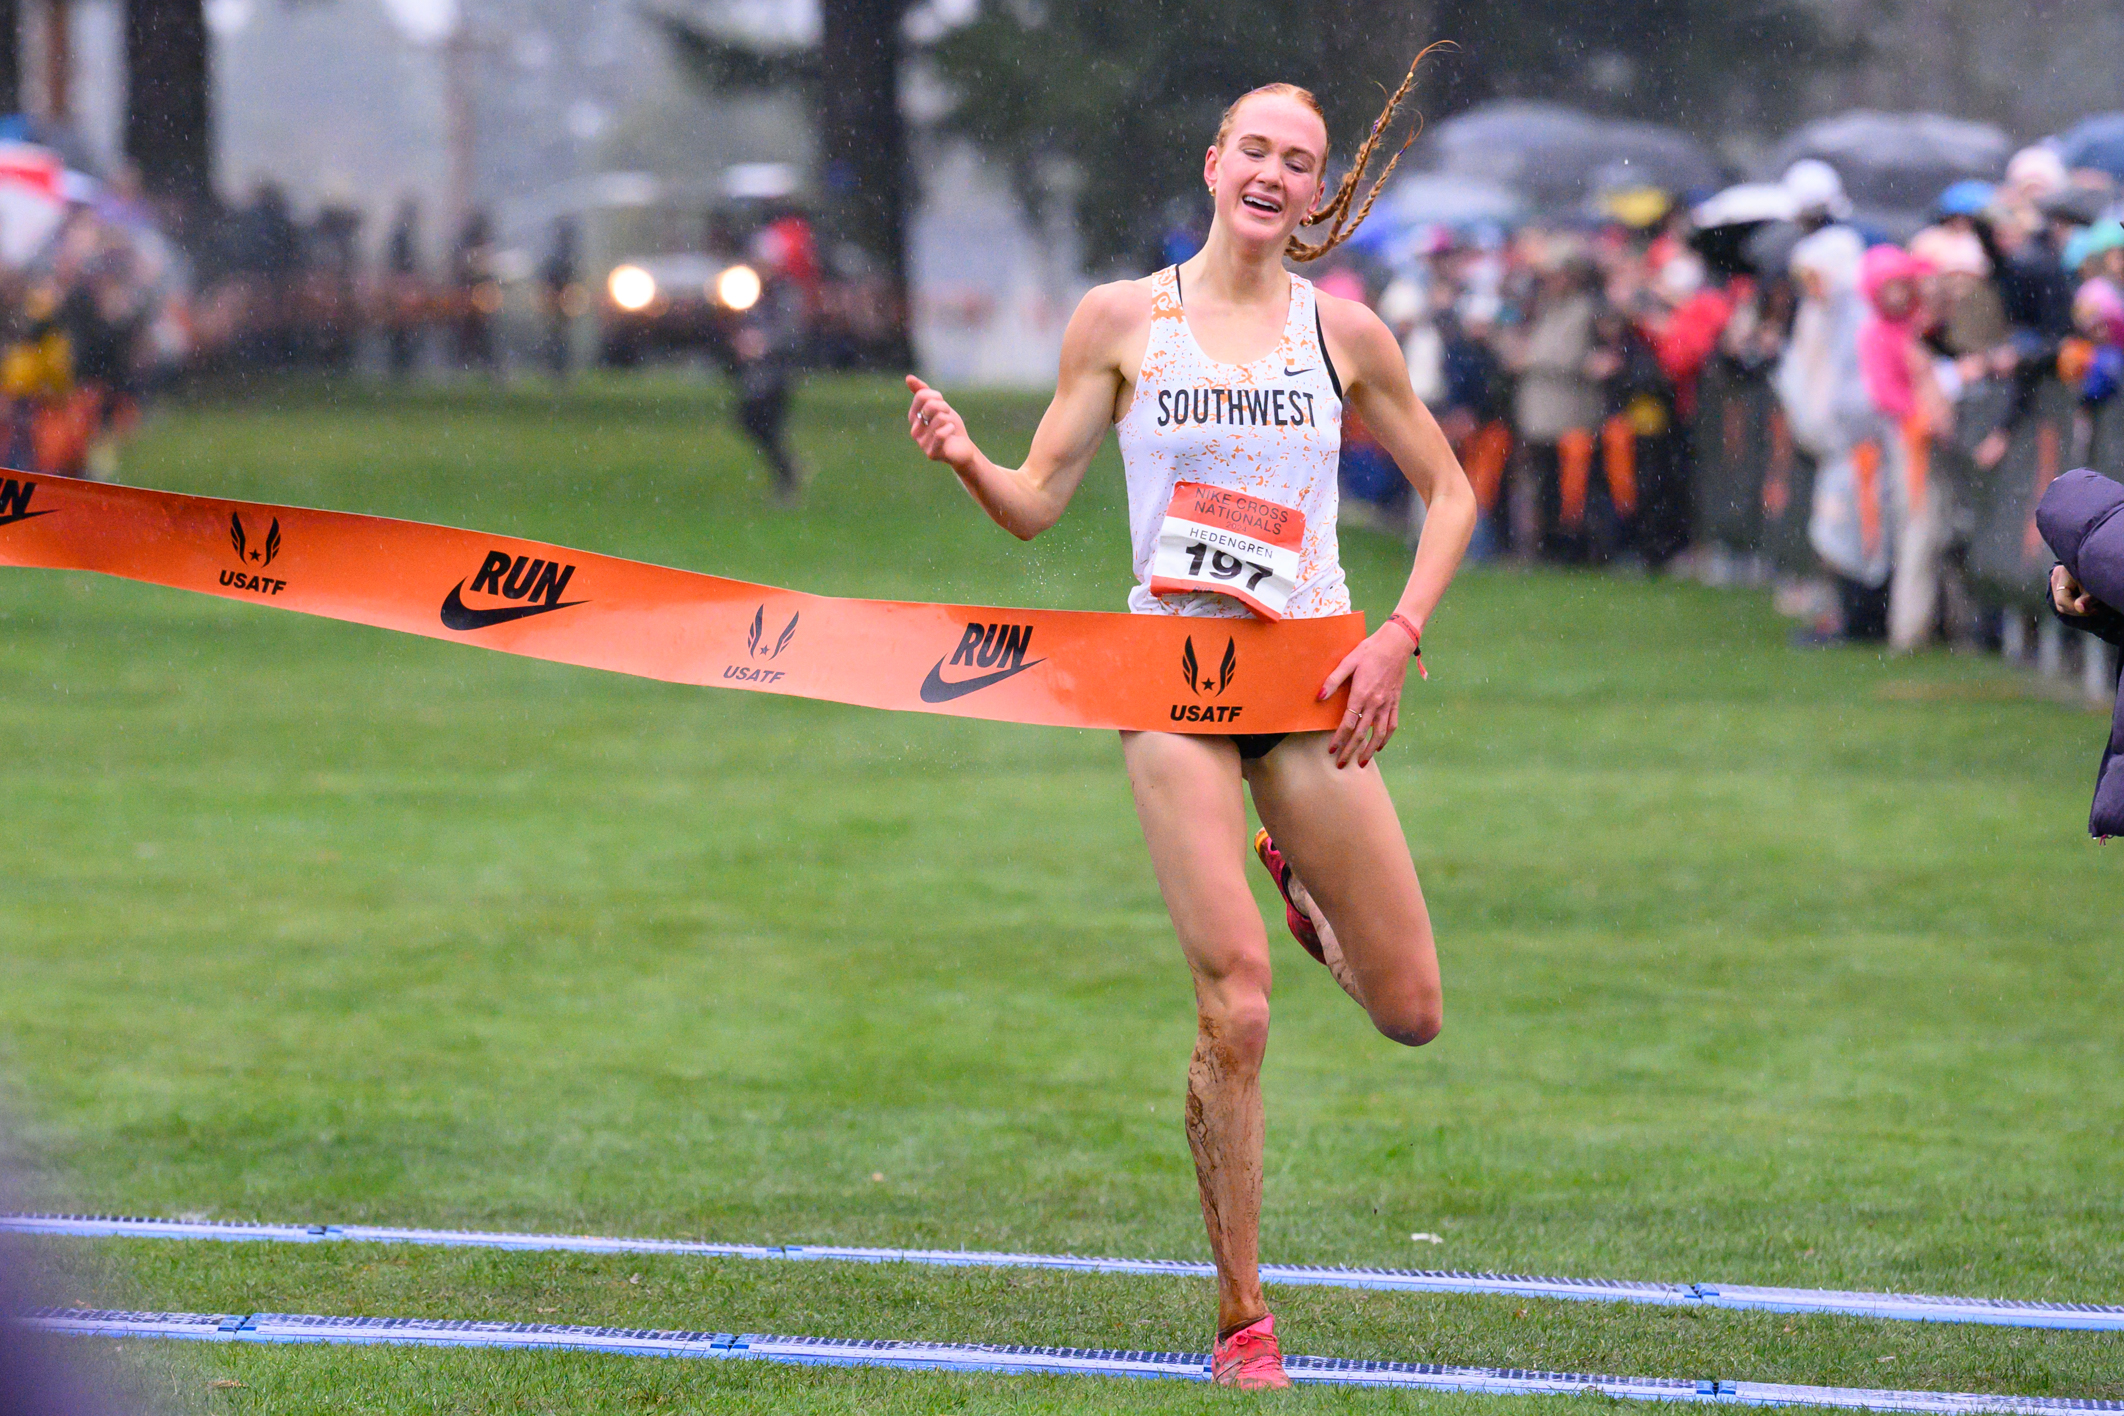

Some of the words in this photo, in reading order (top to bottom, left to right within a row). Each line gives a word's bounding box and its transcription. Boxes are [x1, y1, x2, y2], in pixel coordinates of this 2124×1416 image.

[1157, 388, 1316, 427] SOUTHWEST
[0, 477, 38, 517] N
[1195, 487, 1232, 506] NIKE
[1236, 497, 1288, 523] CROSS
[1194, 500, 1282, 535] NATIONALS
[1225, 521, 1247, 532] 2024
[1189, 527, 1273, 559] HEDENGREN
[219, 569, 287, 596] USATF
[469, 550, 577, 606] RUN
[1185, 542, 1274, 592] 197
[949, 622, 1034, 669] RUN
[722, 665, 786, 684] USATF
[1170, 704, 1243, 722] USATF
